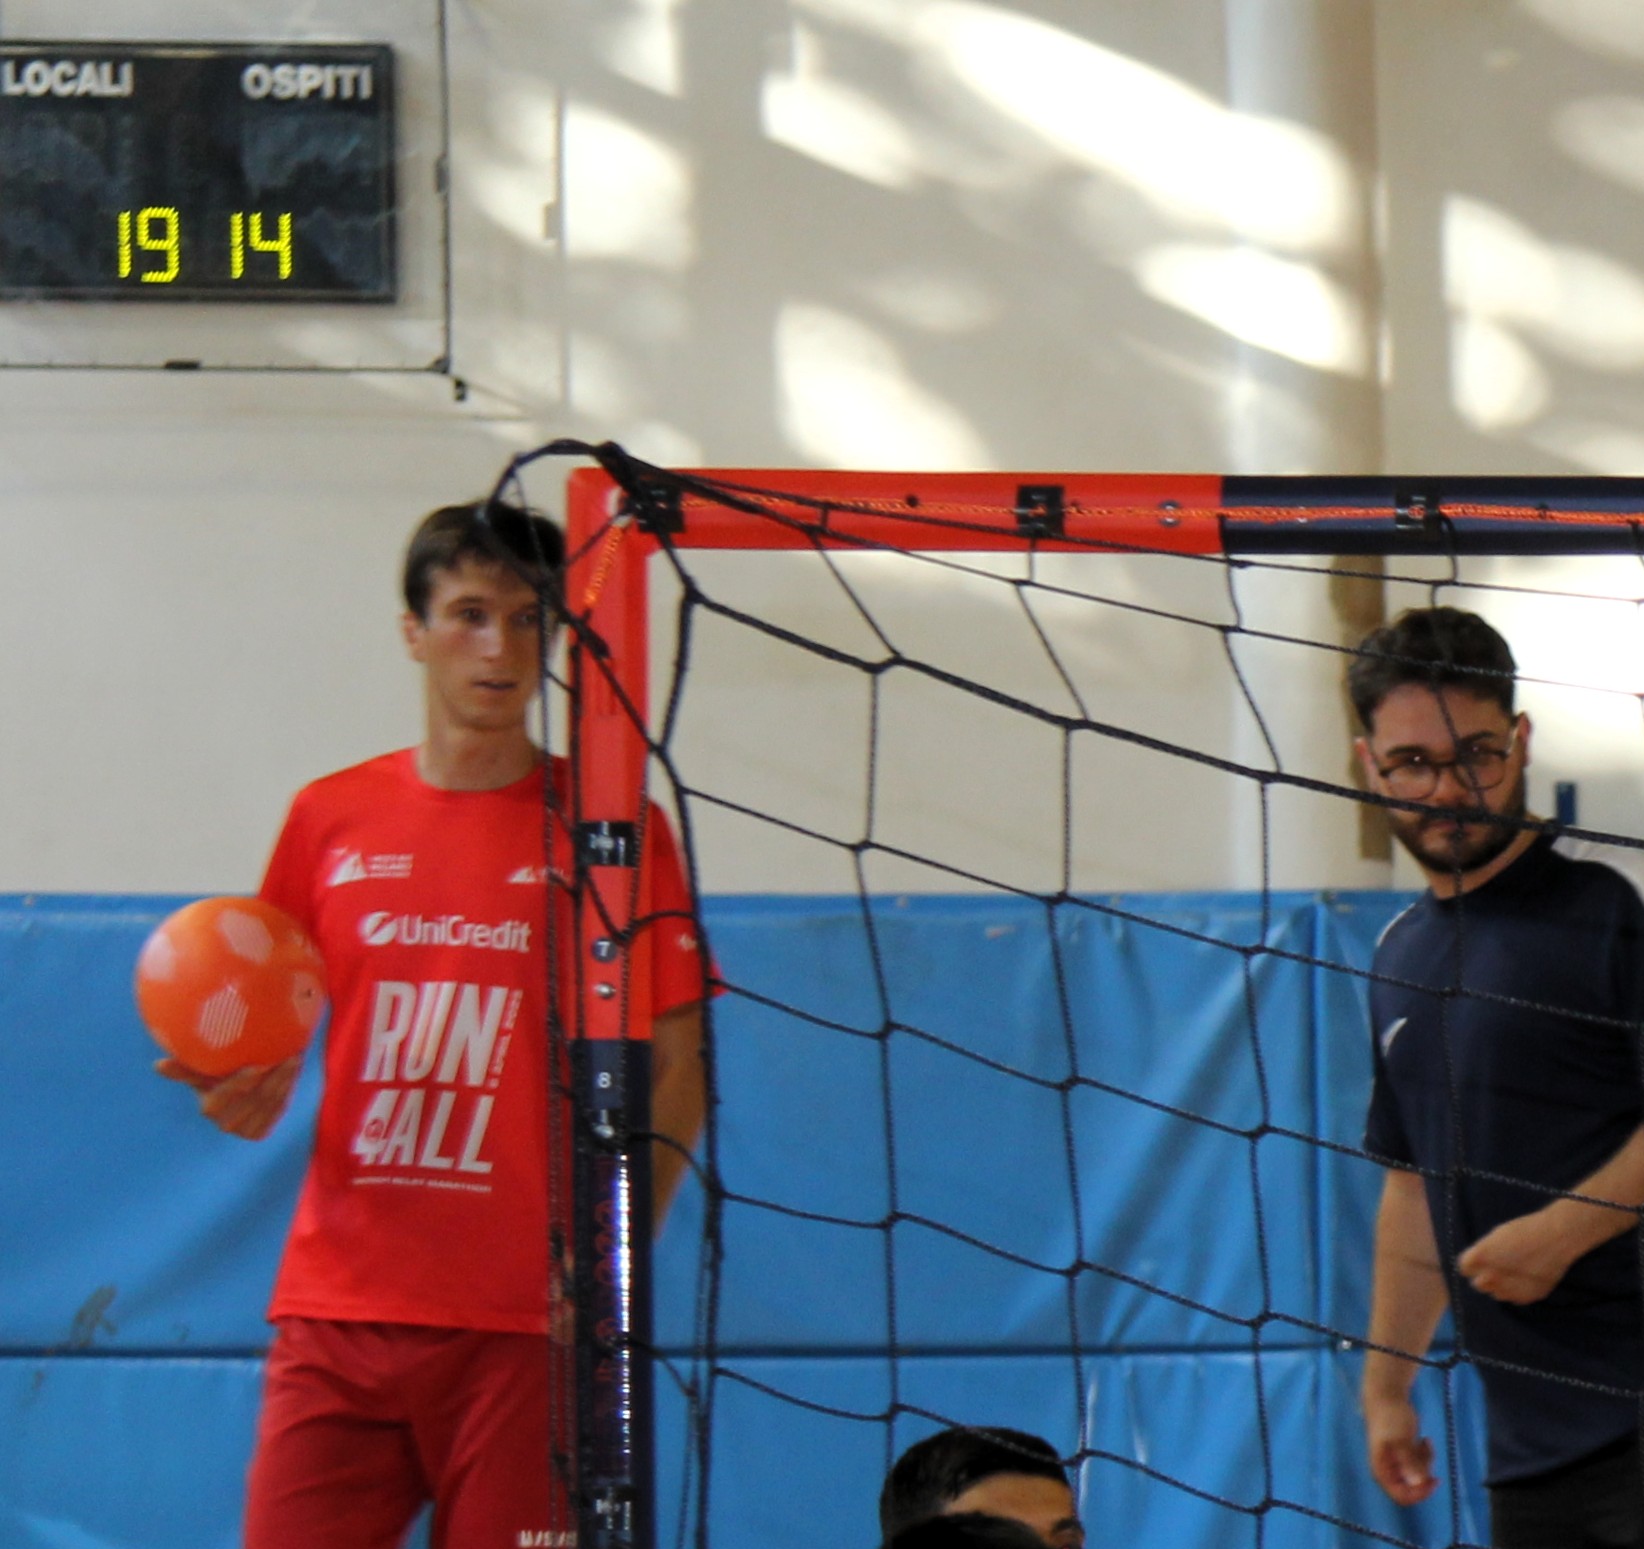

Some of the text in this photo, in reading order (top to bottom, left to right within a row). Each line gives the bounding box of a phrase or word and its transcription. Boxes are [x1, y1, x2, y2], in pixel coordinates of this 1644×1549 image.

[3, 61, 372, 98] LOCALI OSPITI
[118, 207, 292, 282] 19 14
[401, 914, 532, 953] UniCredit
[599, 940, 611, 957] 7
[361, 980, 509, 1088] RUN
[351, 1088, 494, 1174] 4ALL
